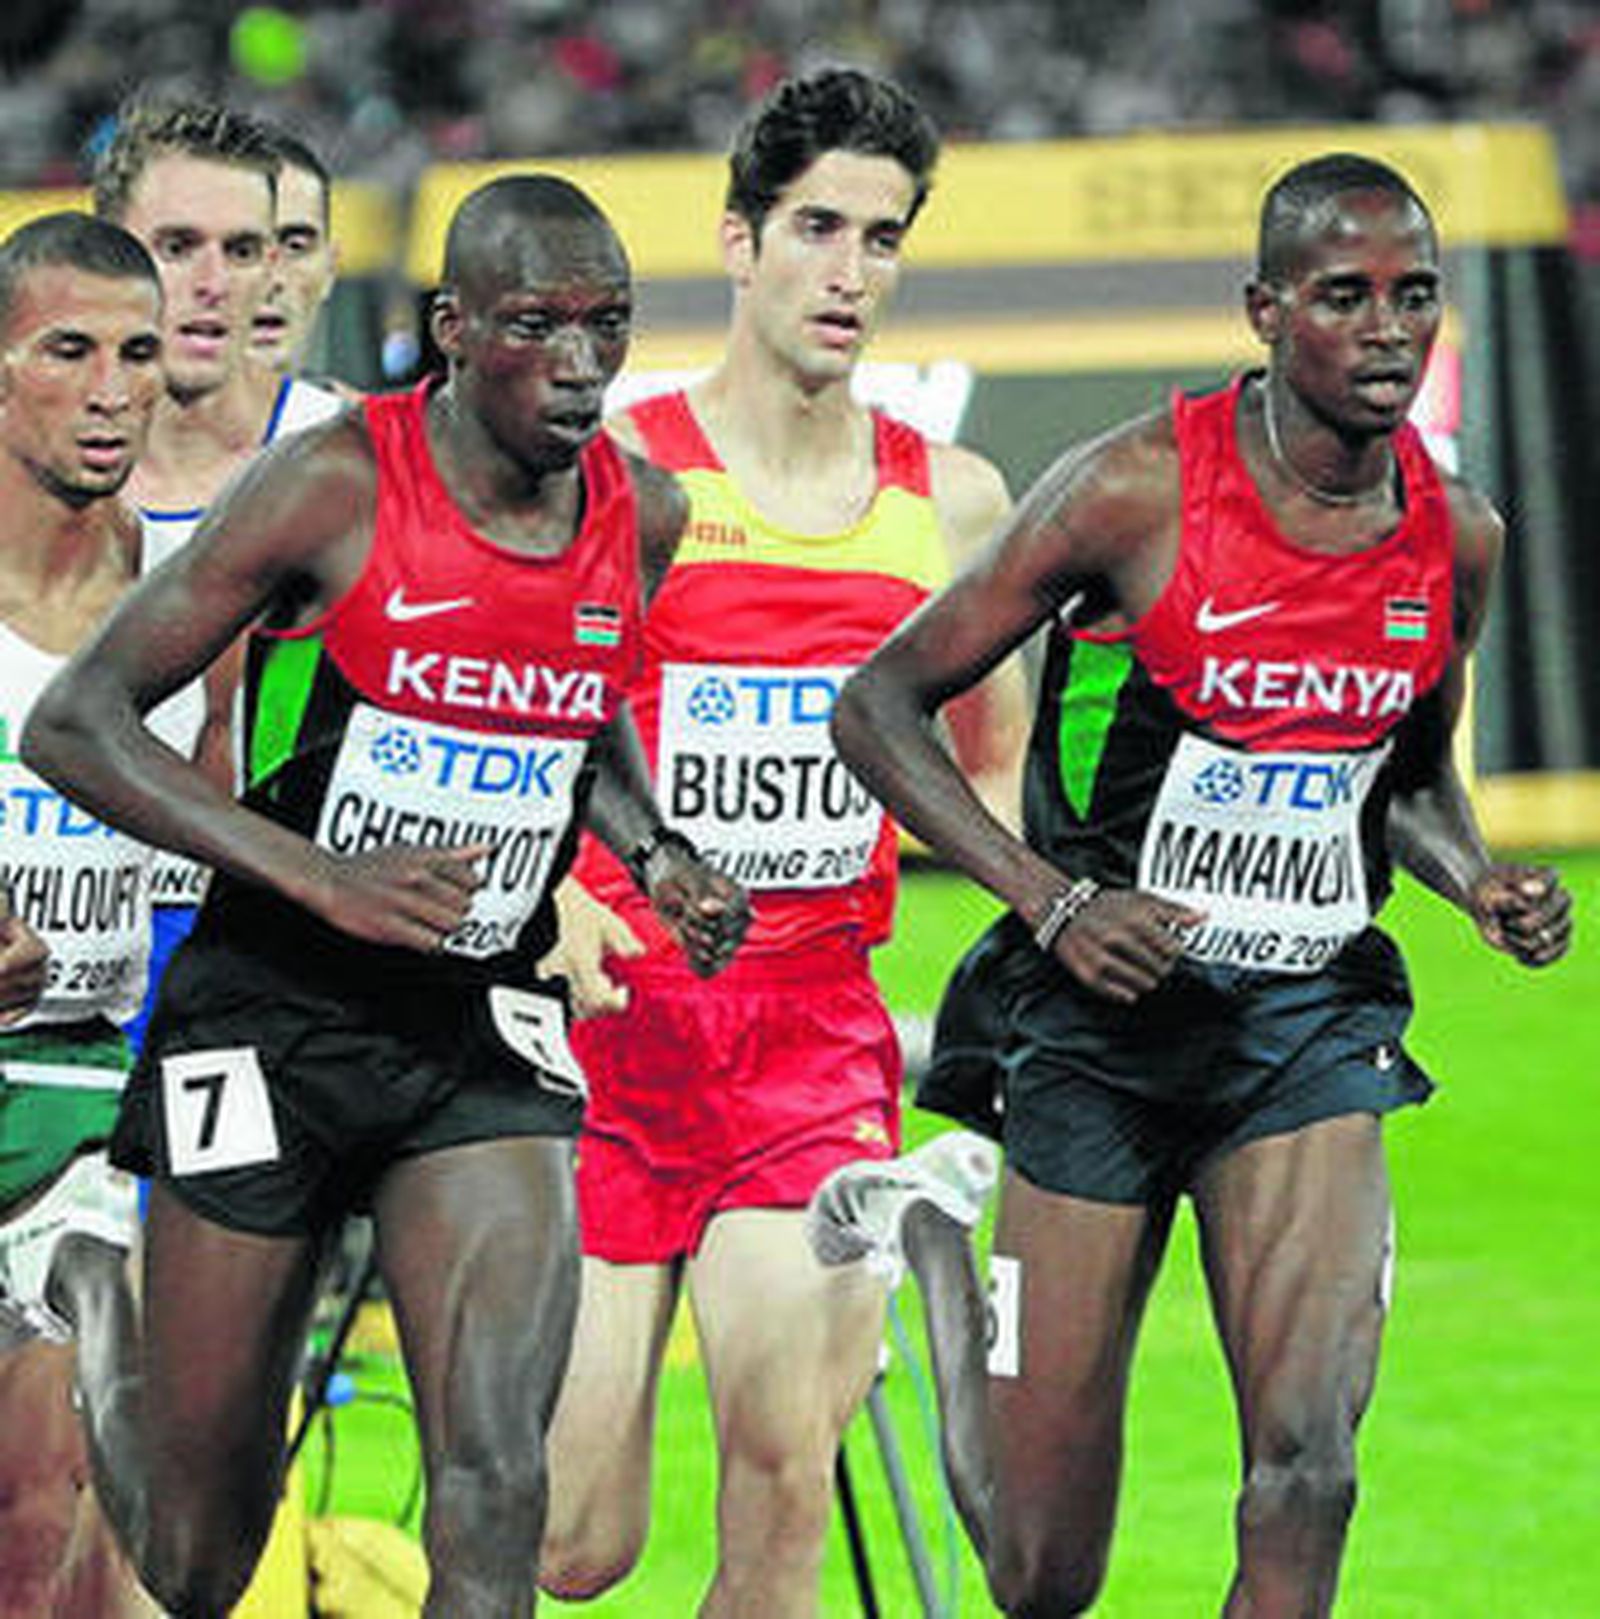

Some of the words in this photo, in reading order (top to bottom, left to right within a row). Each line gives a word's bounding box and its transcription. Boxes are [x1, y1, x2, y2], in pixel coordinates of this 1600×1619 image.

[387, 647, 606, 721] KENYA
[738, 677, 840, 726] TD
[1199, 656, 1415, 717] KENYA
[426, 735, 563, 797] TDK
[8, 787, 114, 838] TD
[181, 1072, 228, 1152] 7
